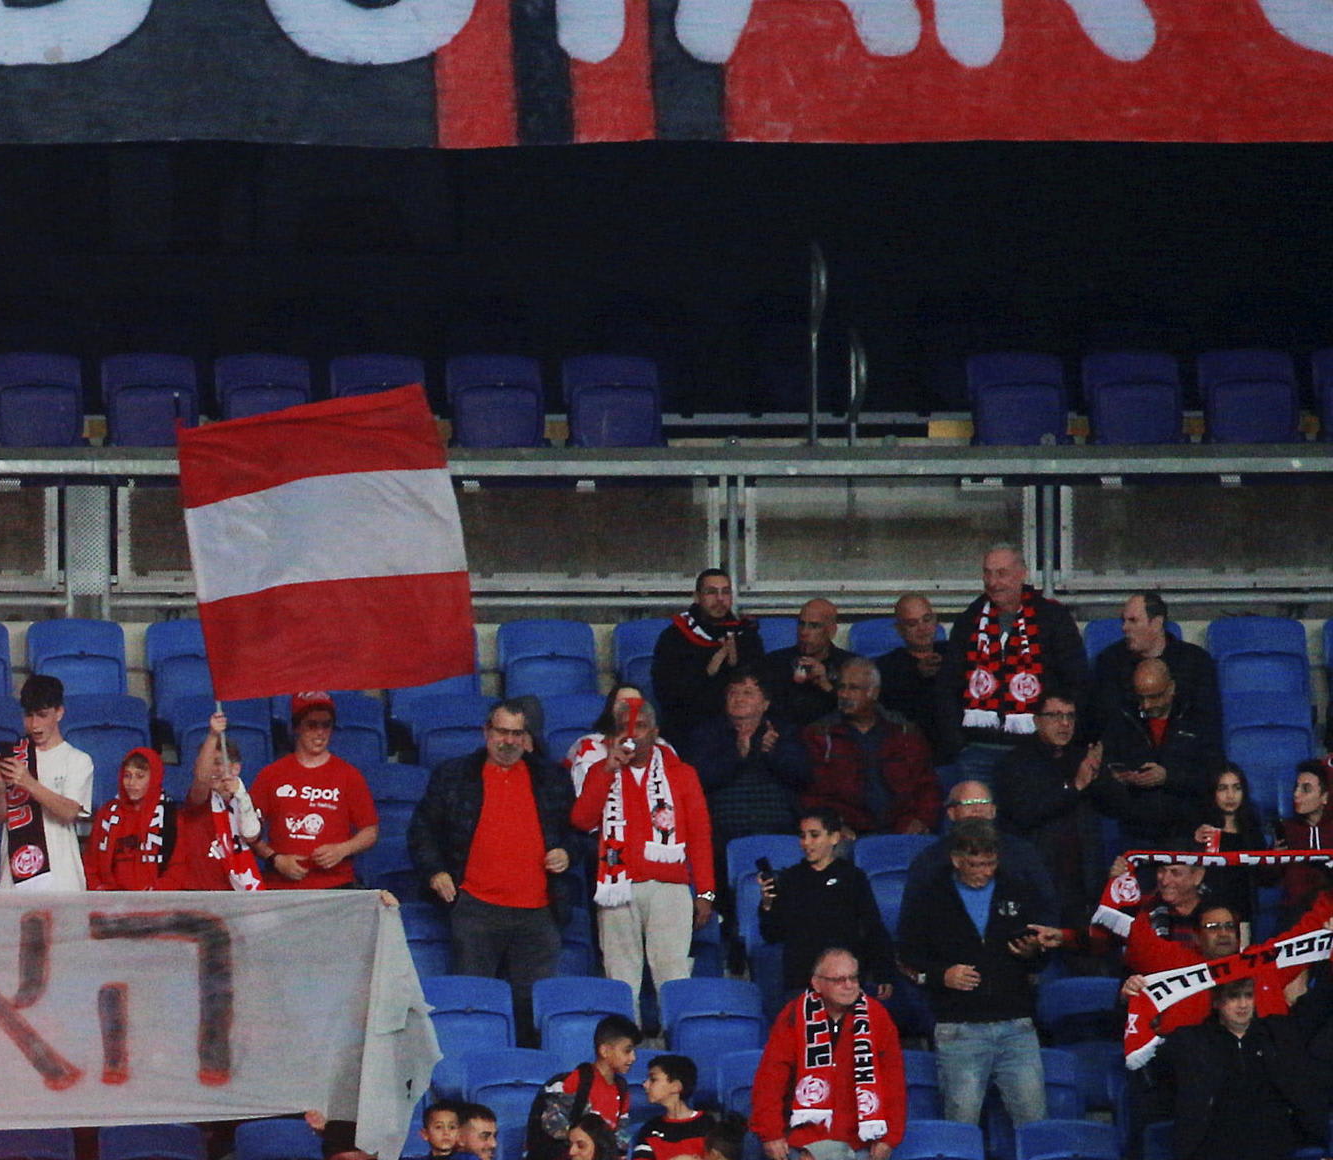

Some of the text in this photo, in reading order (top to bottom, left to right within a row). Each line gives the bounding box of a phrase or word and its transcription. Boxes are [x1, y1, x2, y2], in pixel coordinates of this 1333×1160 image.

[300, 786, 340, 802] Spot
[1147, 932, 1333, 1002] הפועל חדרה
[853, 1039, 876, 1084] RED
